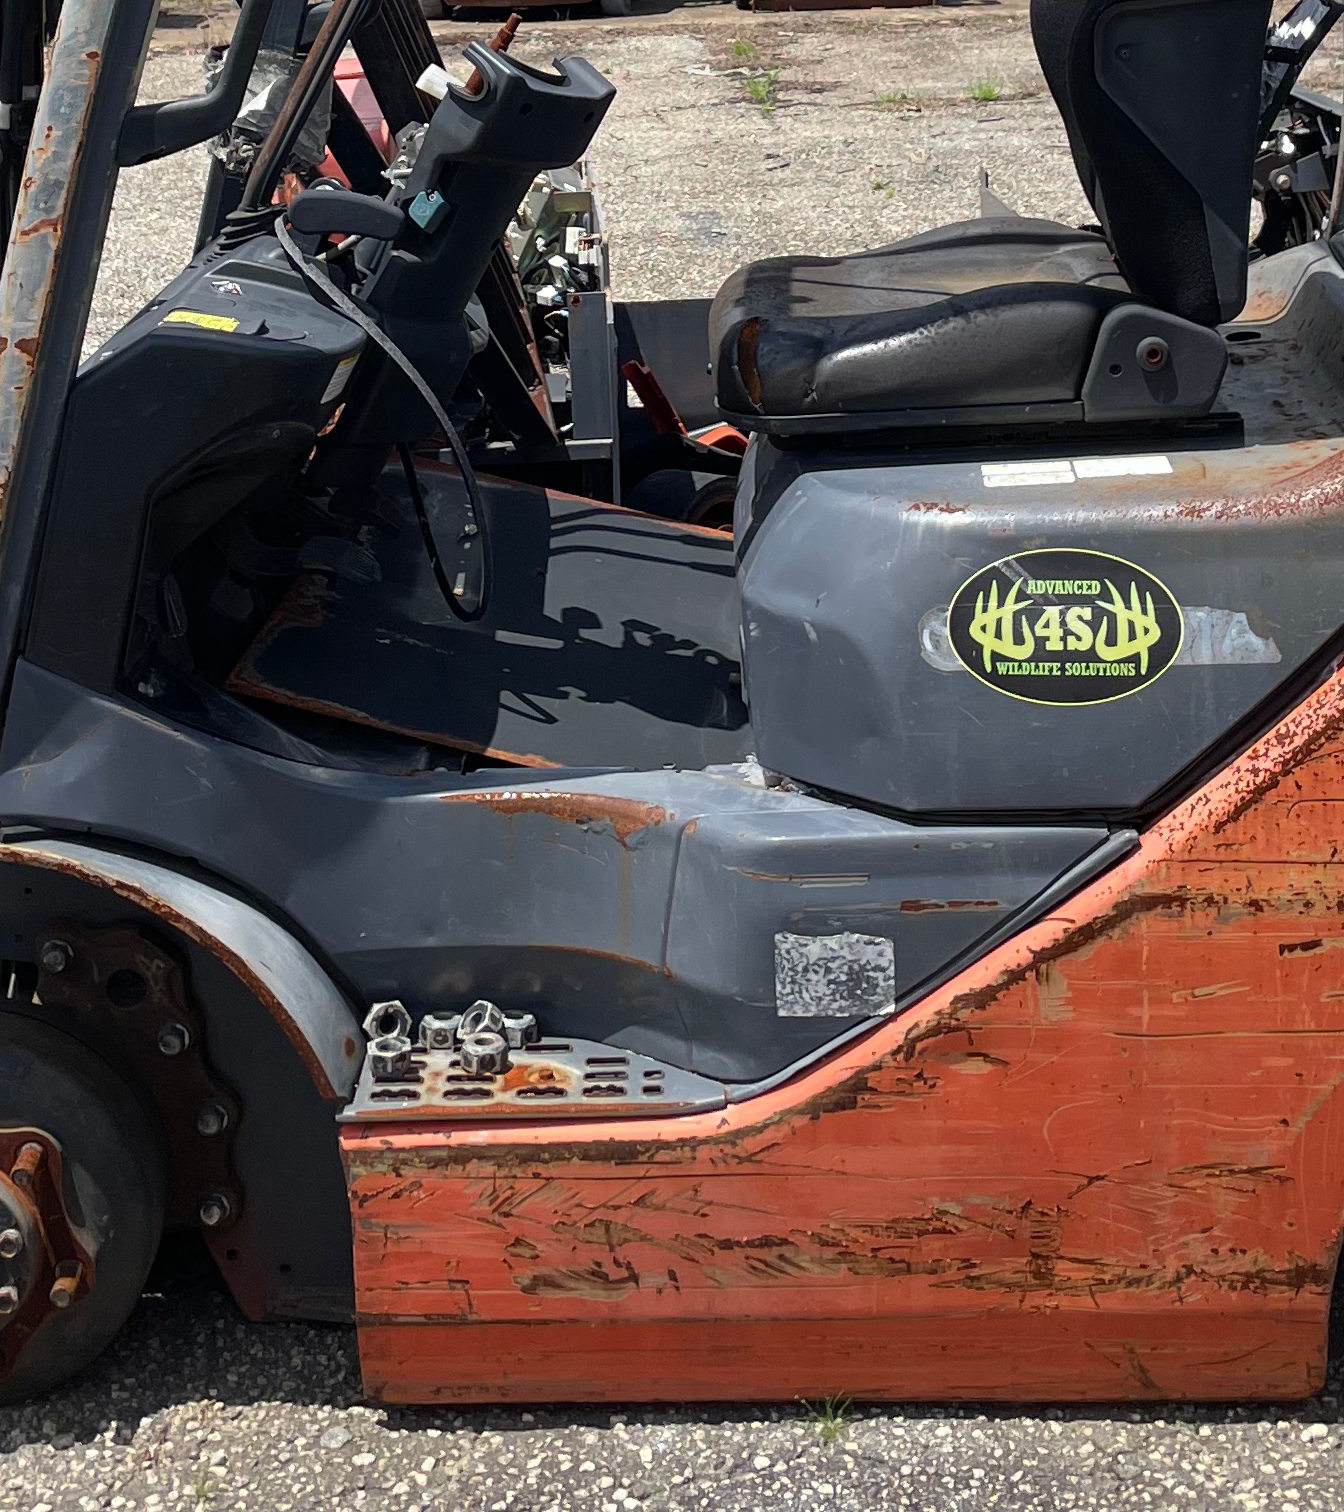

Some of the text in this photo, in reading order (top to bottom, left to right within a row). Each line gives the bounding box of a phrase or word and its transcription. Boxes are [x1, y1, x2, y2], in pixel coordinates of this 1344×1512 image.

[1026, 579, 1101, 595] ADVANCED
[1034, 605, 1094, 651] 4S
[996, 661, 1136, 677] WILDLIFE SOLUTIONS
